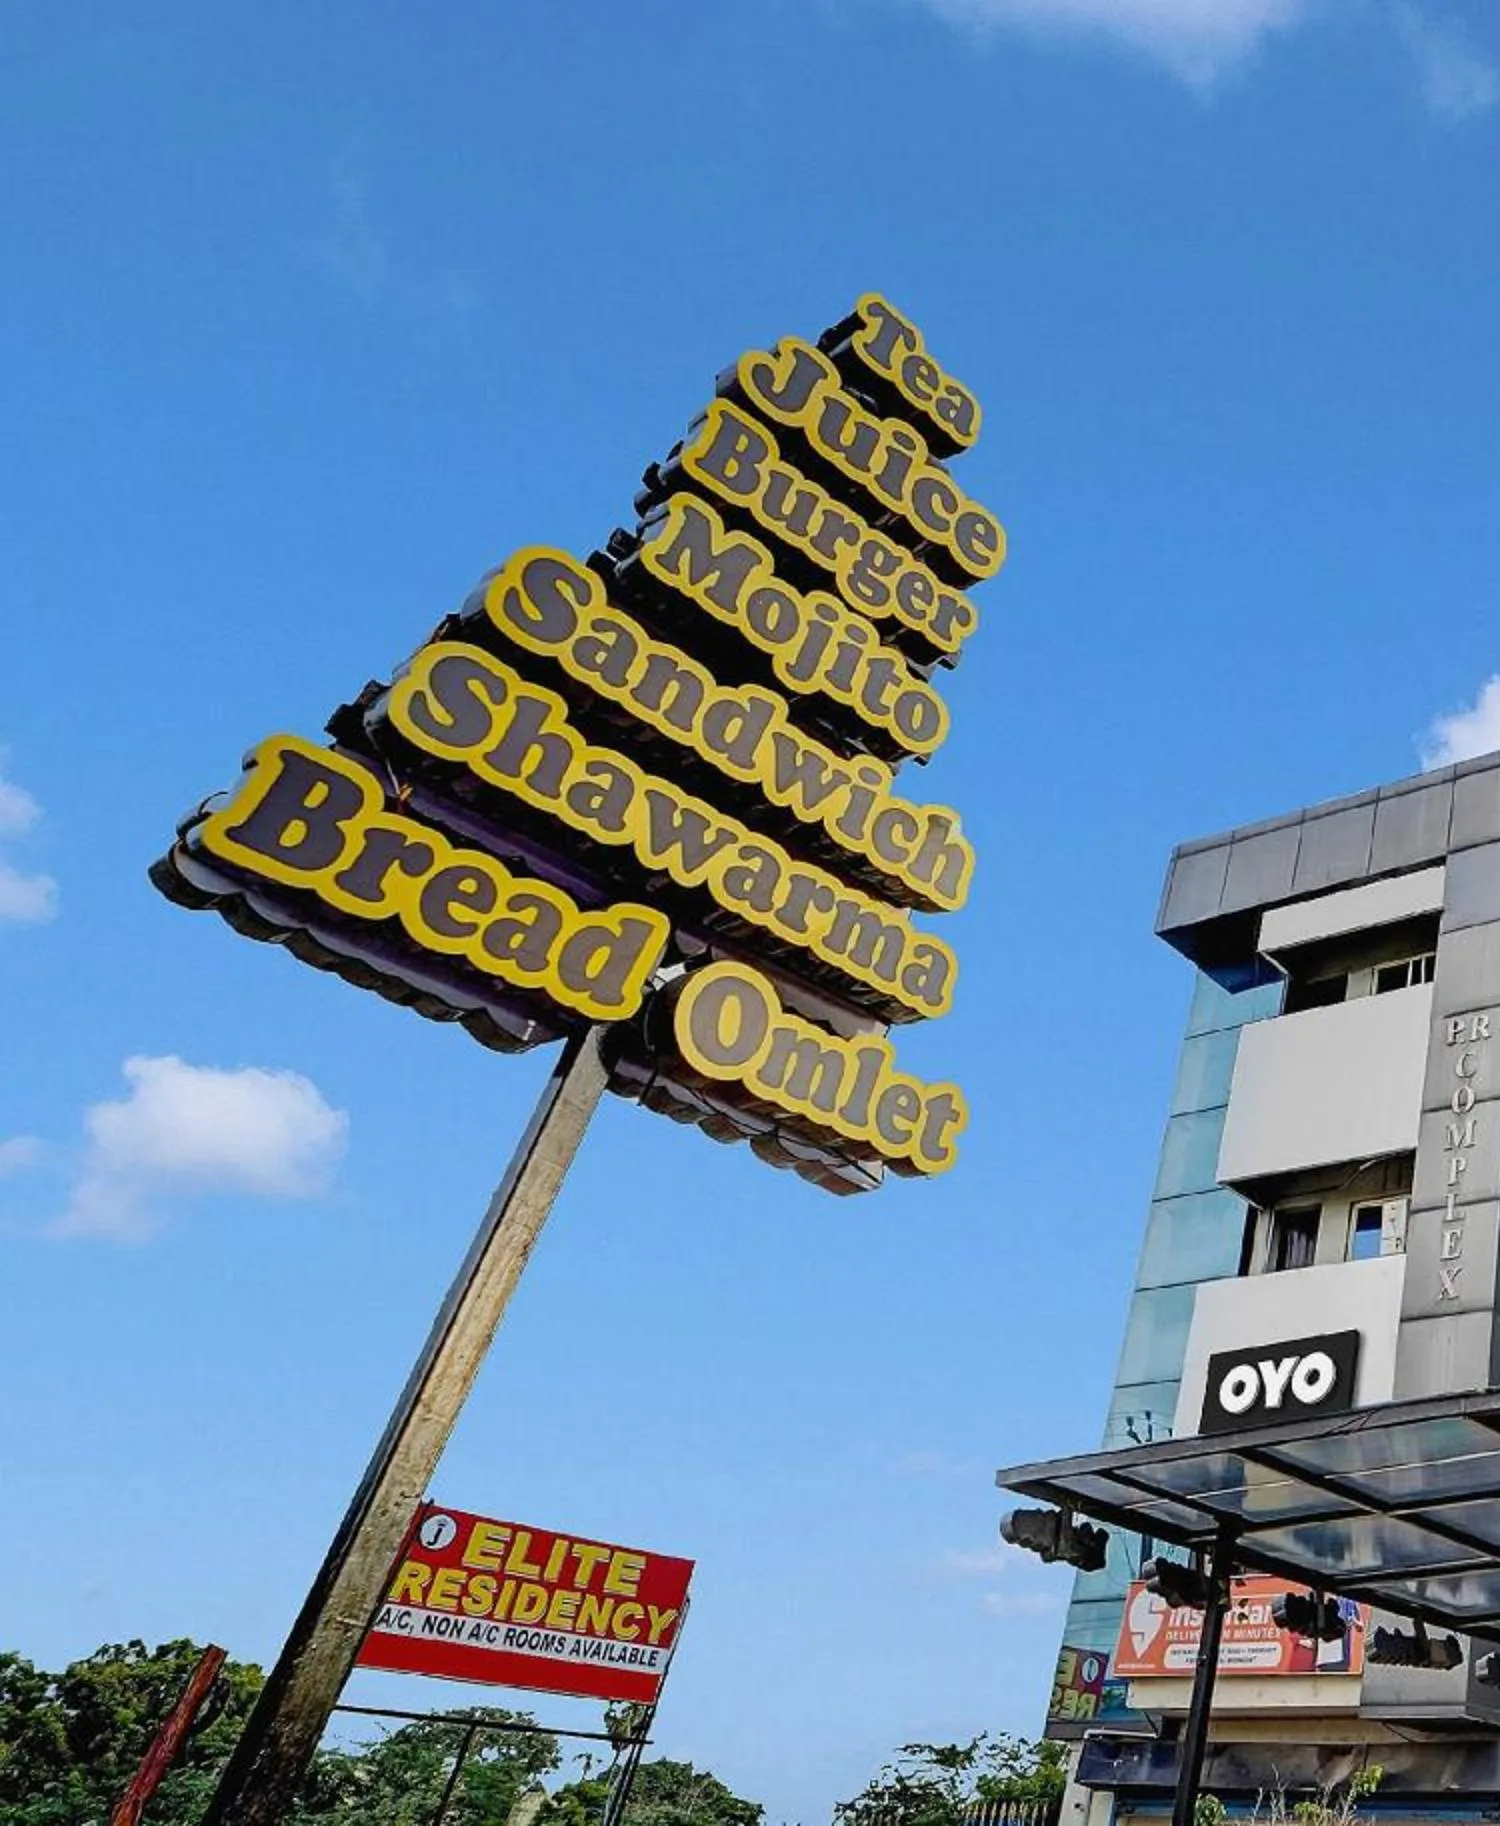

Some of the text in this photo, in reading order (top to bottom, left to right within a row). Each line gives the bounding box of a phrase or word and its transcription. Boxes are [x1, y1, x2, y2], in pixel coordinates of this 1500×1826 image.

[749, 344, 1000, 566] Juice
[861, 298, 979, 441] Tea
[650, 502, 945, 745] Mojito
[690, 405, 974, 647] Burger
[403, 652, 953, 1010] Shawarma
[498, 553, 969, 902] Sandwich
[225, 745, 665, 1011] Bread
[687, 970, 967, 1164] Omlet
[1439, 1051, 1478, 1302] COMPLEX
[1218, 1350, 1337, 1415] OYO
[376, 1606, 660, 1669] A/C, NON A/C ROOMS AVAILABLE
[387, 1560, 680, 1647] RESIDENCY
[461, 1520, 648, 1599] ELITE
